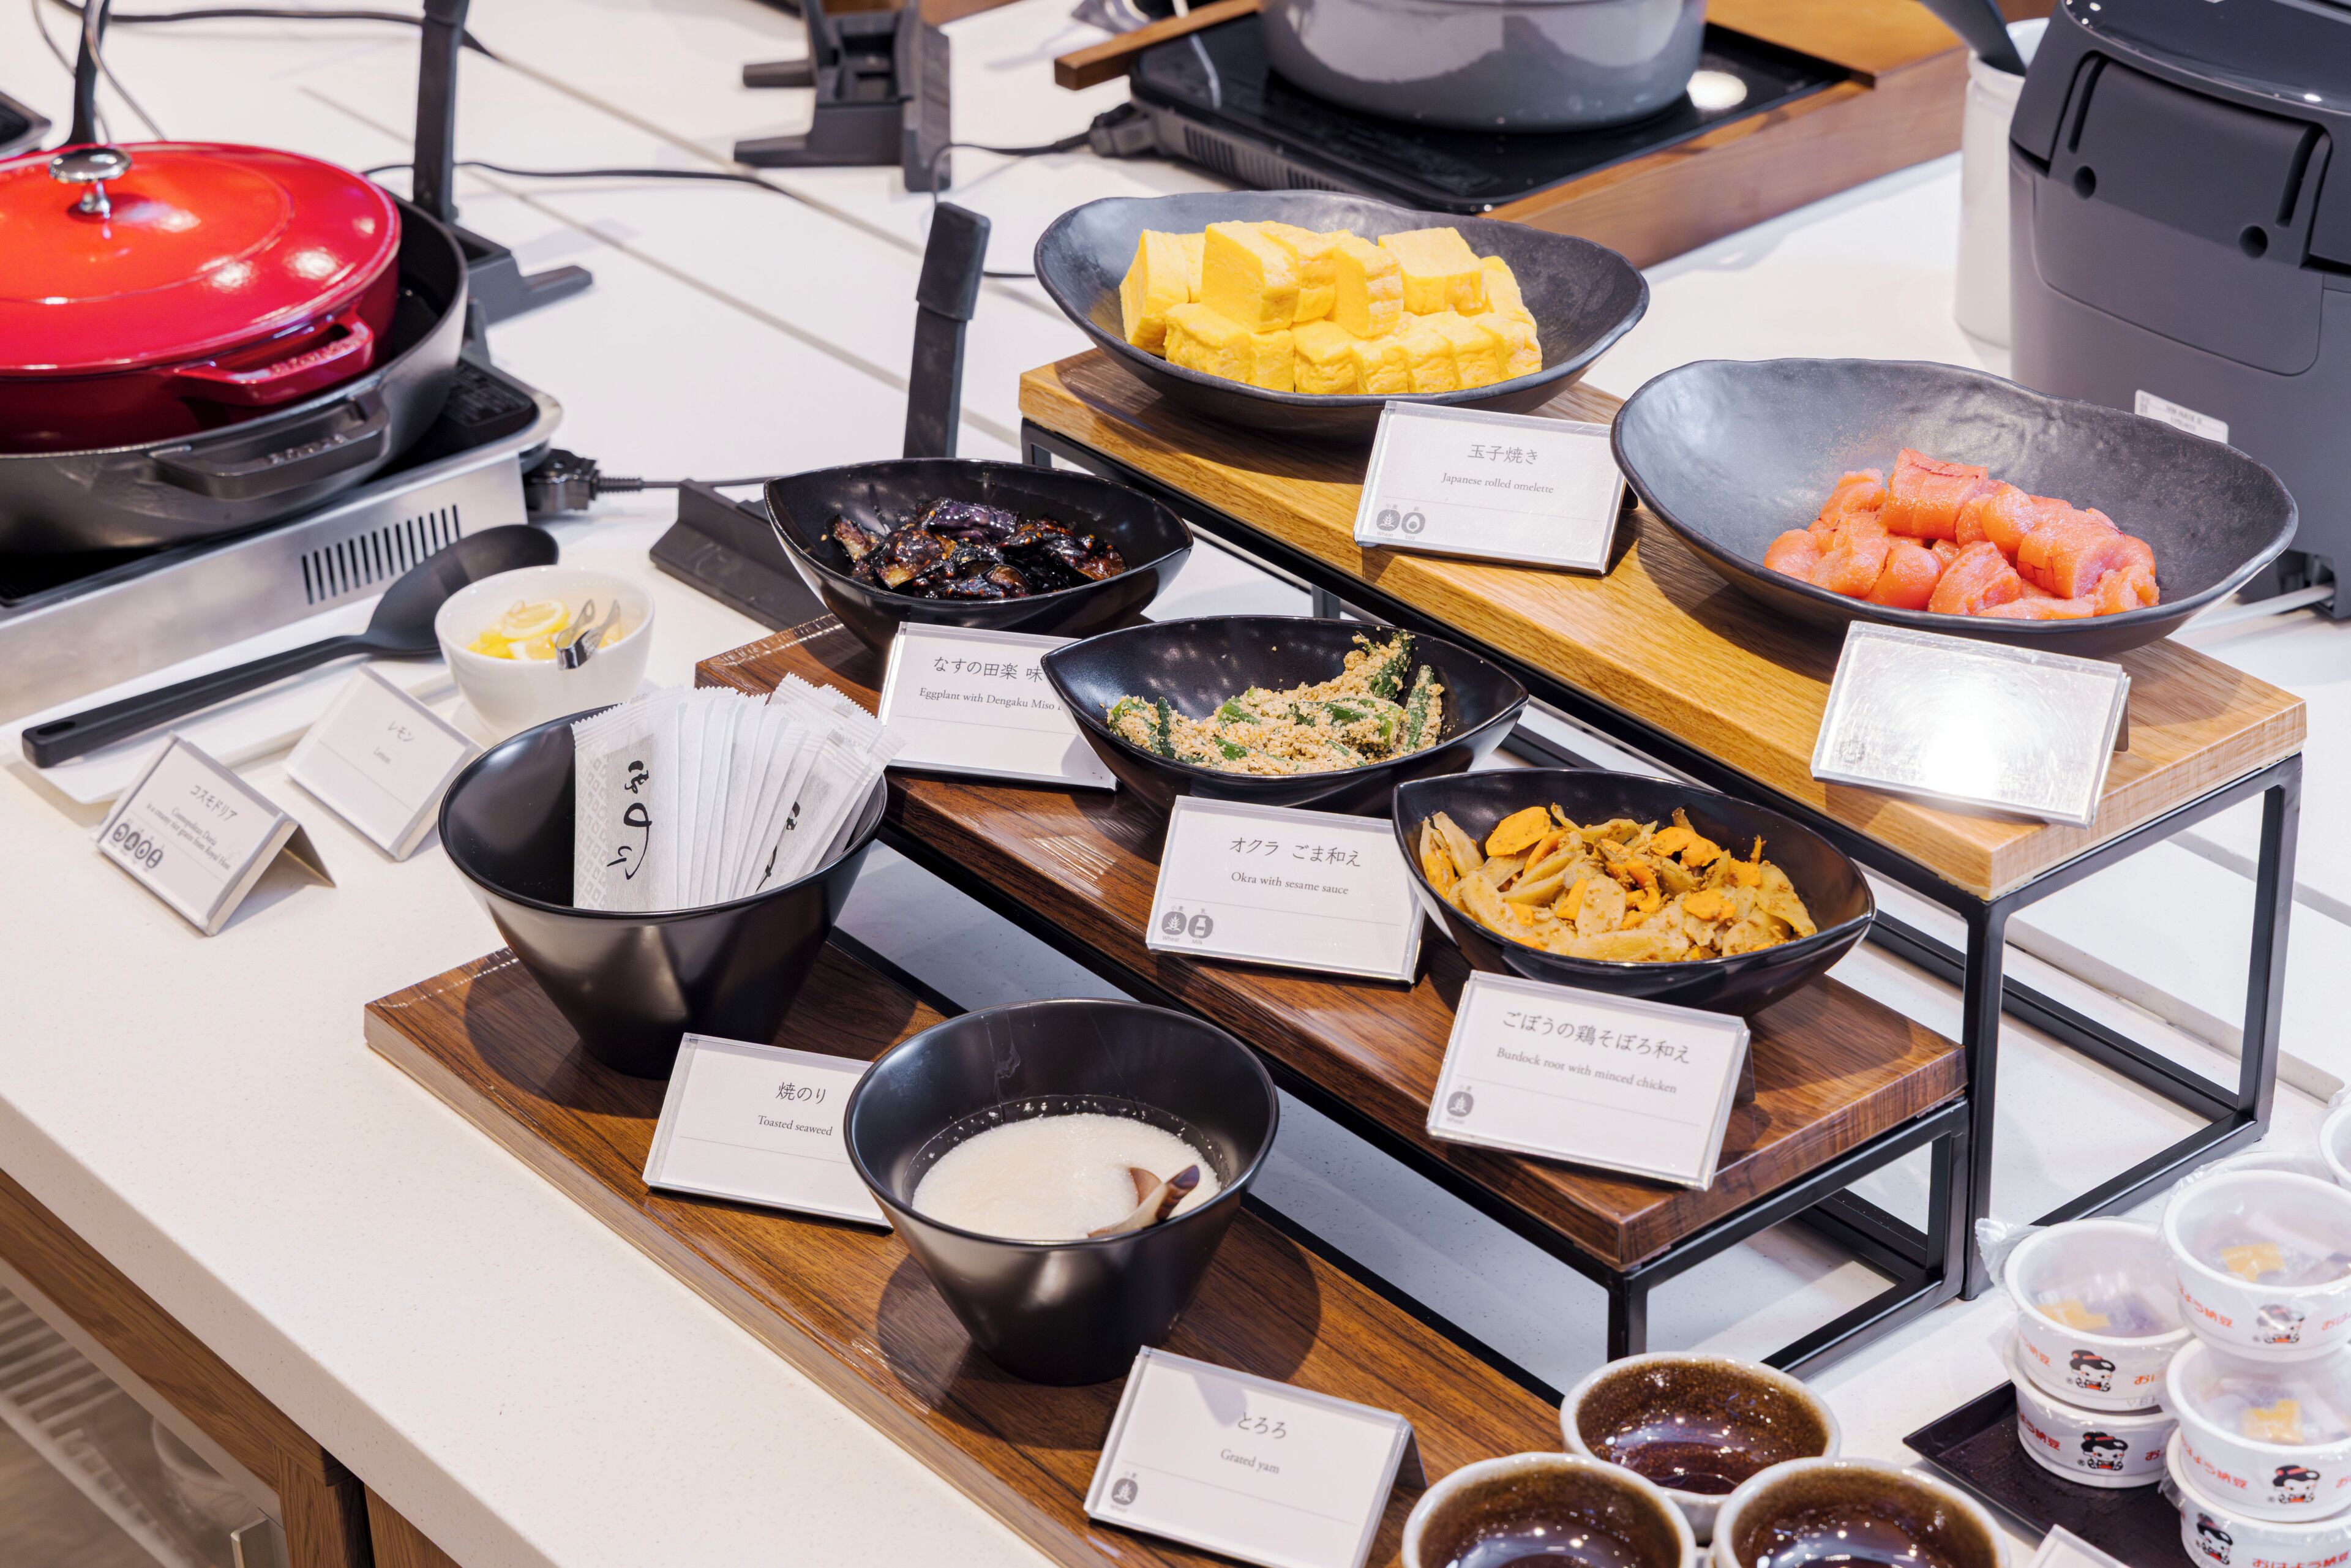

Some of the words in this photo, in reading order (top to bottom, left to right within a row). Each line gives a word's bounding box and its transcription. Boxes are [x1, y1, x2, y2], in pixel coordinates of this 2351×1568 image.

[1467, 444, 1538, 465] 玉子焼き
[1441, 473, 1482, 486] Japanese
[1485, 477, 1511, 489] rolled
[1513, 482, 1554, 493] omelette
[934, 656, 1017, 680] なすの田楽
[919, 688, 960, 702] Eggplant
[963, 692, 983, 703] with
[986, 694, 1028, 709] Dengaku
[1031, 699, 1054, 710] Miso
[387, 720, 415, 743] レモン
[189, 784, 238, 821] コスモドリア
[1229, 837, 1279, 857] オクラ
[1292, 844, 1361, 868] ごま和え
[1231, 871, 1256, 884] Okra
[1260, 876, 1282, 887] with
[1285, 881, 1319, 891] sesame
[1322, 885, 1349, 895] sauce
[1502, 1011, 1690, 1064] ごぼうの鶏そぼろ和え
[1496, 1047, 1540, 1066] Burdock
[1543, 1059, 1565, 1071] root
[1568, 1062, 1591, 1076] with
[1595, 1068, 1634, 1086] minced
[1637, 1076, 1677, 1094] chicken
[775, 1082, 826, 1105] 焼のり
[758, 1115, 793, 1130] Toasted
[795, 1123, 833, 1136] seaweed
[1237, 1412, 1287, 1439] とろろ
[1220, 1449, 1256, 1468] Grated
[1256, 1460, 1280, 1475] yam
